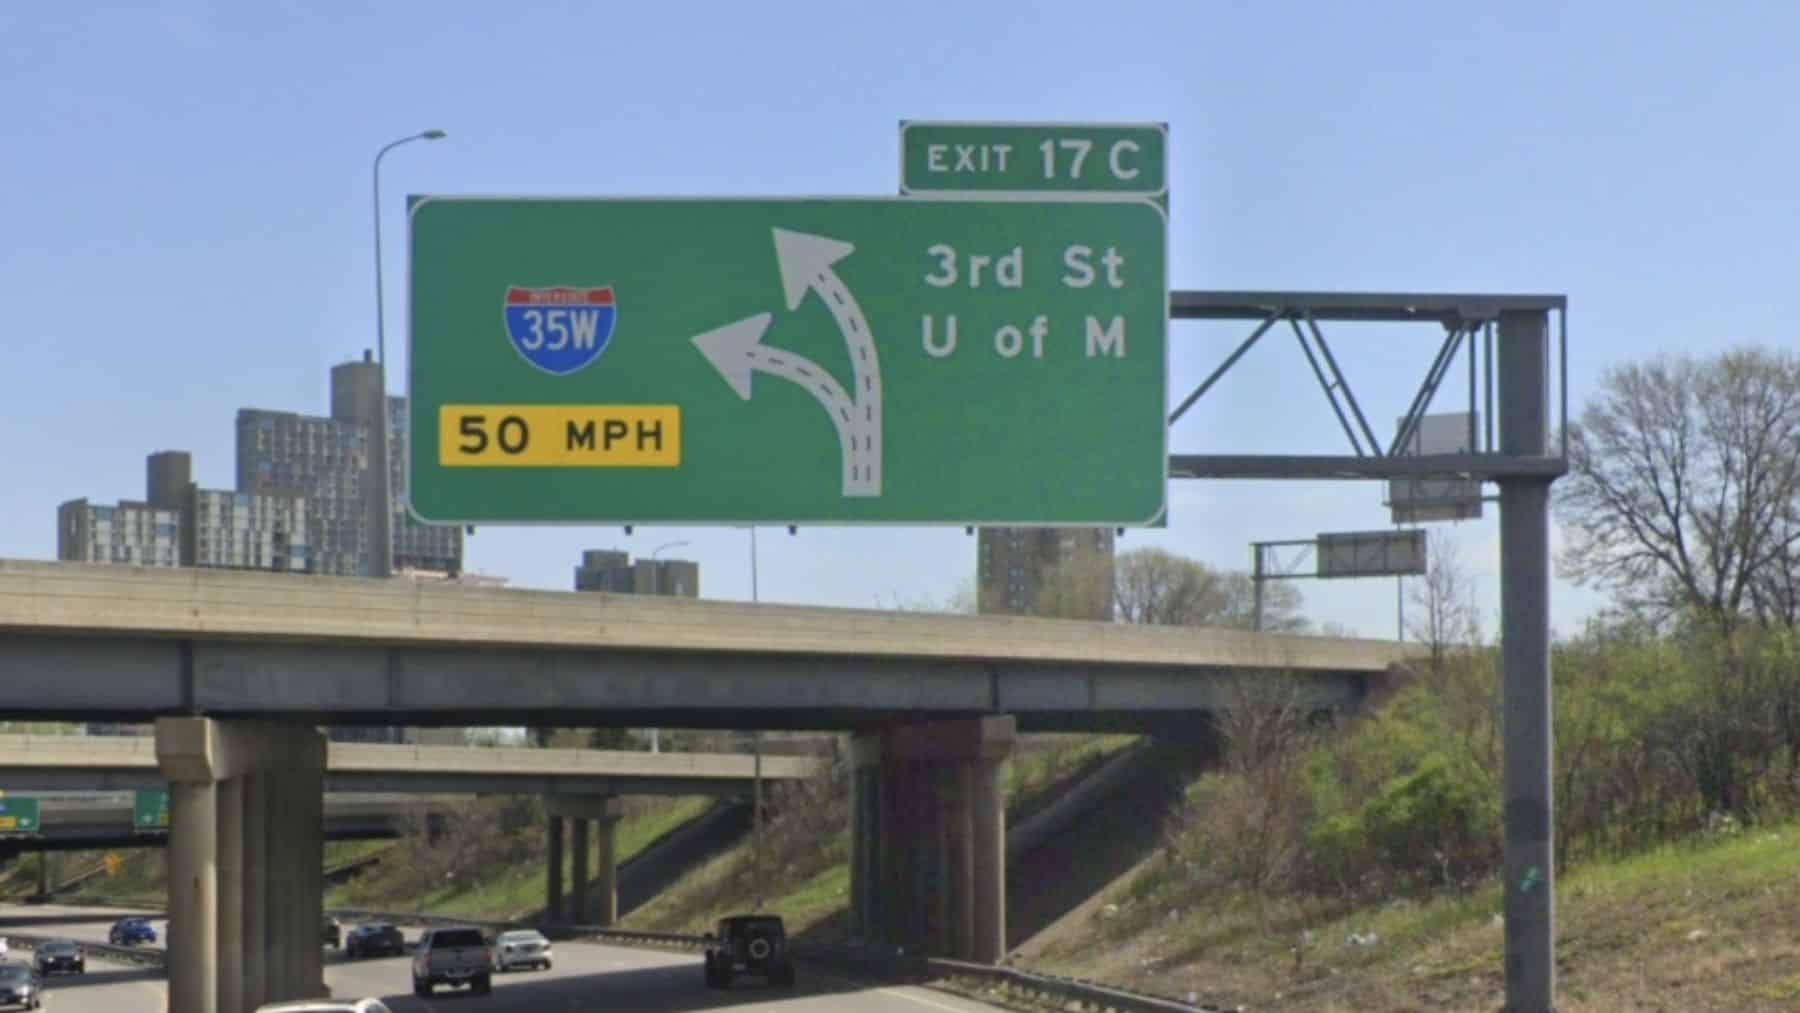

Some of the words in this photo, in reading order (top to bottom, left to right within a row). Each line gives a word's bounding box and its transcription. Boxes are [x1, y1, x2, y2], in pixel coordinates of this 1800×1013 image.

[928, 144, 1012, 172] EXIT
[1039, 139, 1092, 179] 17
[1109, 139, 1140, 180] C
[925, 243, 1023, 288] 3rd
[1061, 244, 1125, 288] St
[521, 309, 600, 351] 35W
[922, 314, 957, 358] U
[994, 315, 1048, 358] of
[1086, 316, 1126, 358] M
[458, 414, 530, 455] 50
[566, 419, 663, 452] MPH
